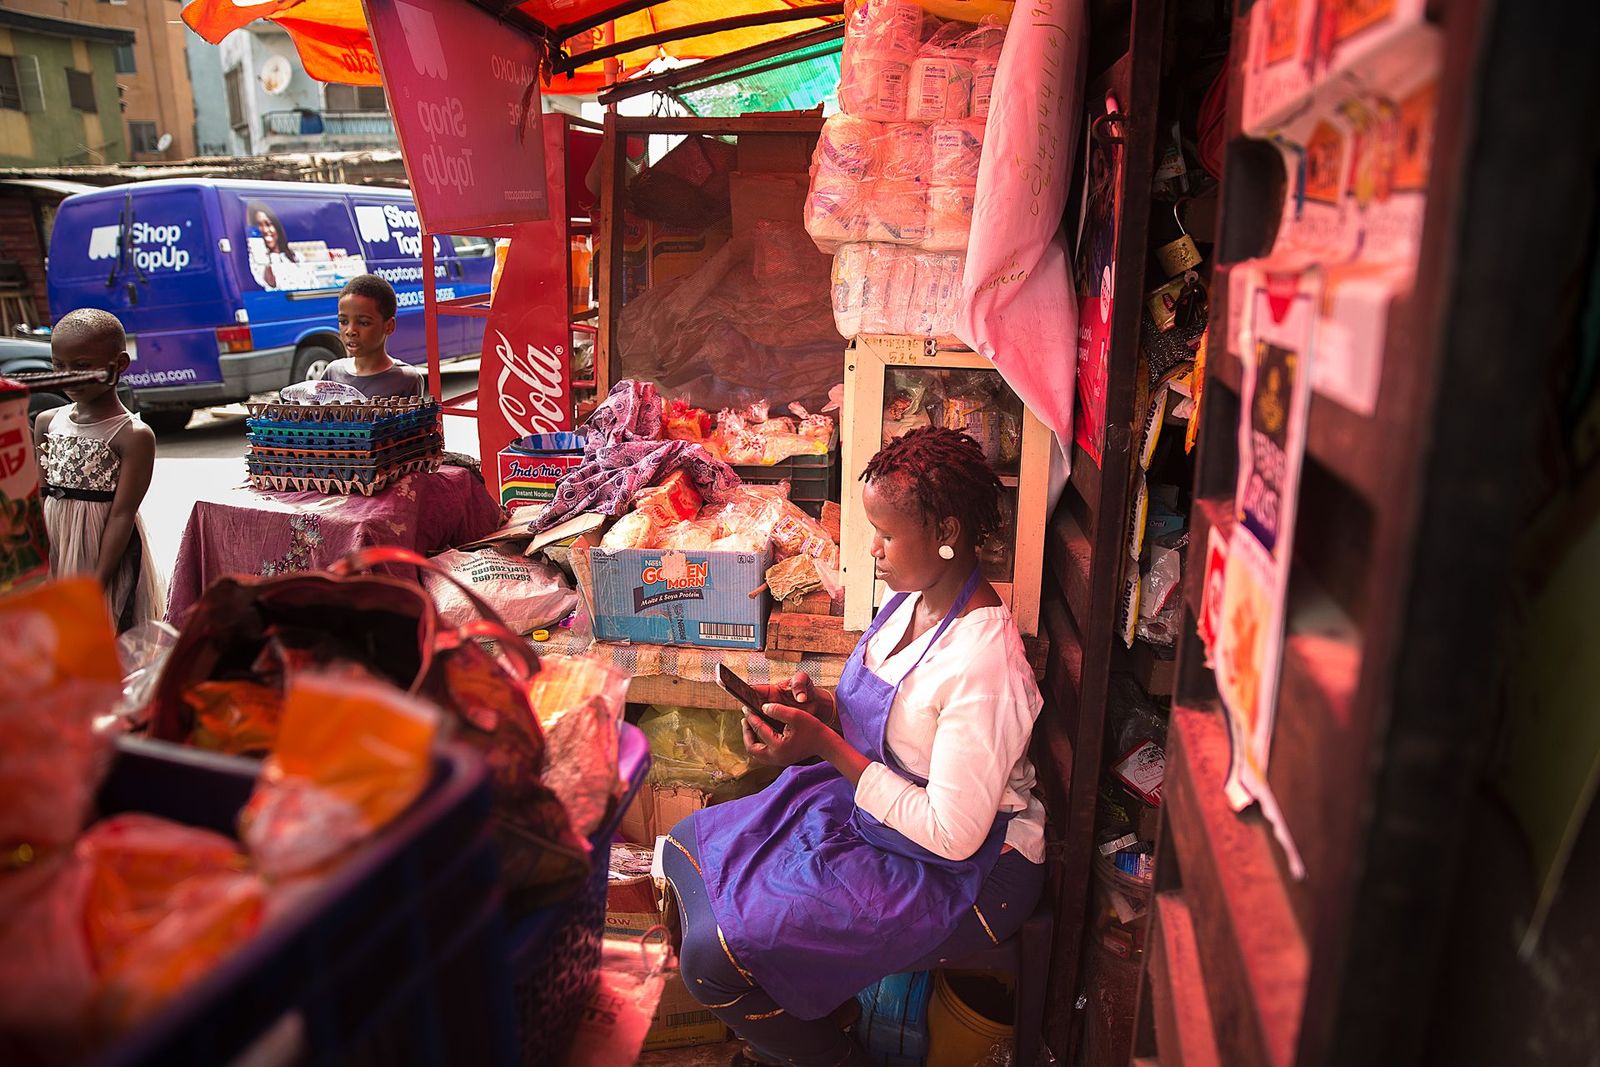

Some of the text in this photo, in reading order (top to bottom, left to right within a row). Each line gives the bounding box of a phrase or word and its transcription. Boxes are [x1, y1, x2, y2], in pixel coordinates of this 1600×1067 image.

[132, 221, 181, 247] Shop
[495, 328, 564, 438] Cola
[515, 489, 555, 500] Instant Noodles
[666, 576, 706, 590] MORN
[664, 593, 679, 601] Soya
[679, 591, 700, 599] Protein
